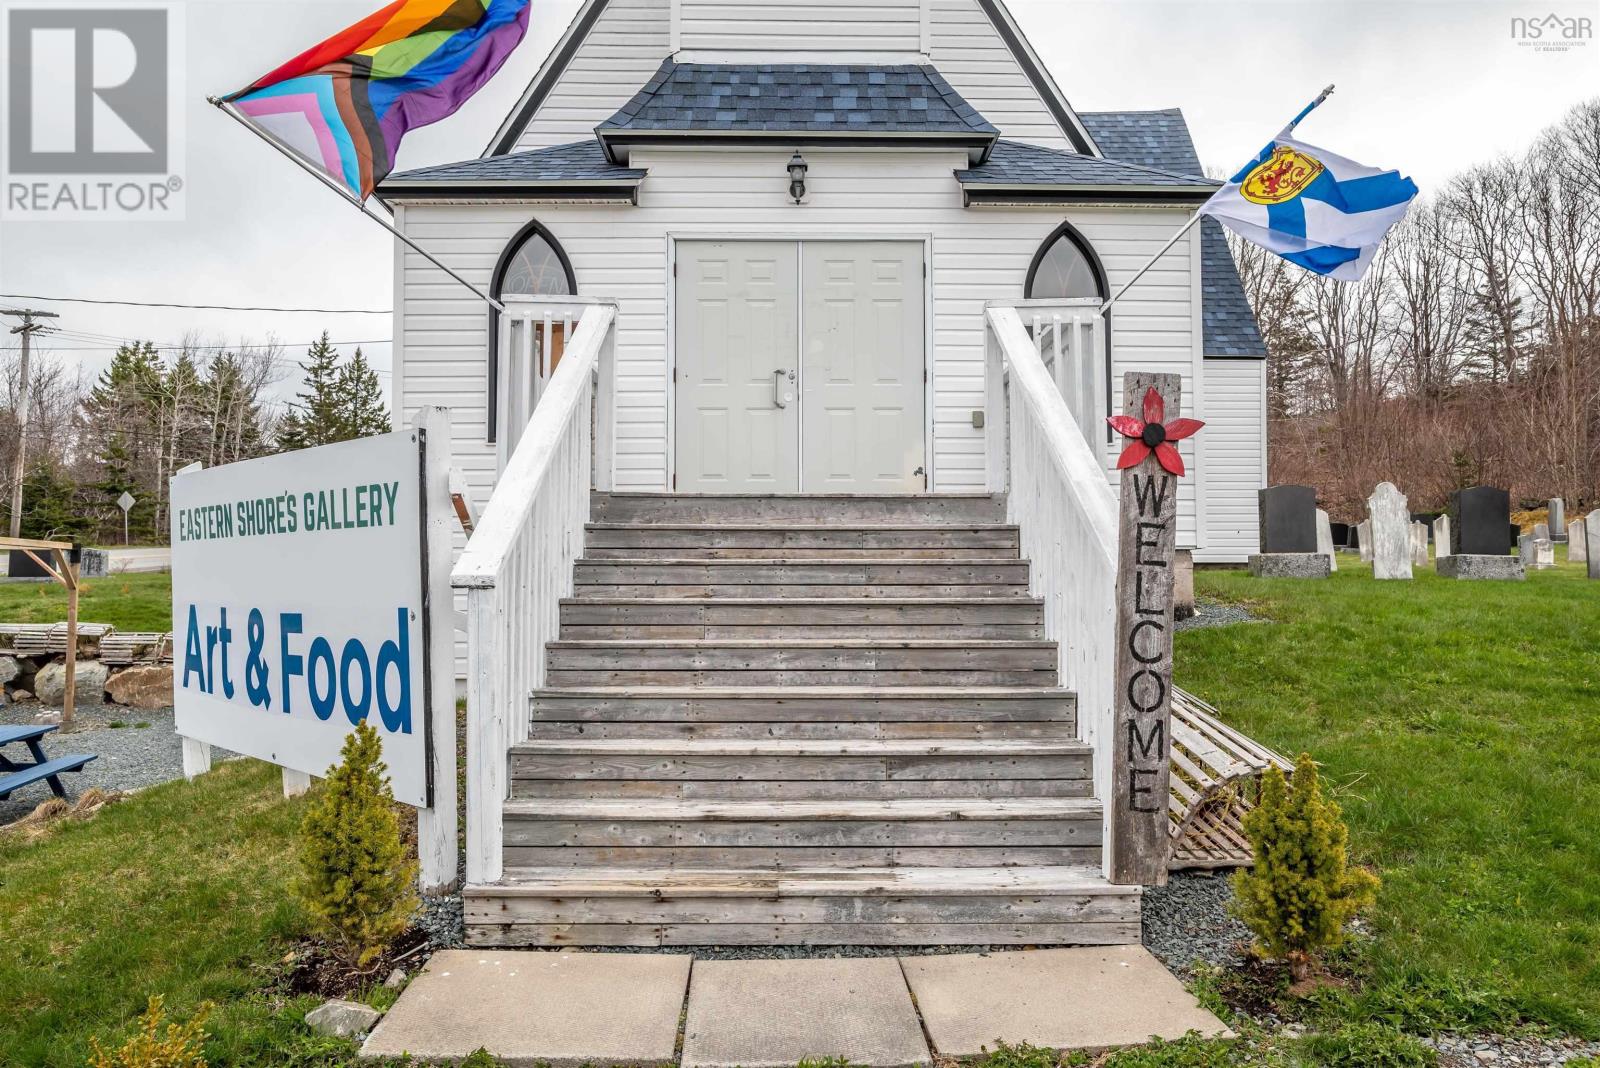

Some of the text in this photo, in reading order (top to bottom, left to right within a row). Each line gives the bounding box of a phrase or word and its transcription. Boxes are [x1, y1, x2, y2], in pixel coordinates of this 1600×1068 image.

[179, 481, 399, 542] EASTERN SHORE'S GALLERY
[182, 603, 413, 735] Art & Food
[1127, 473, 1169, 815] WELCOME
